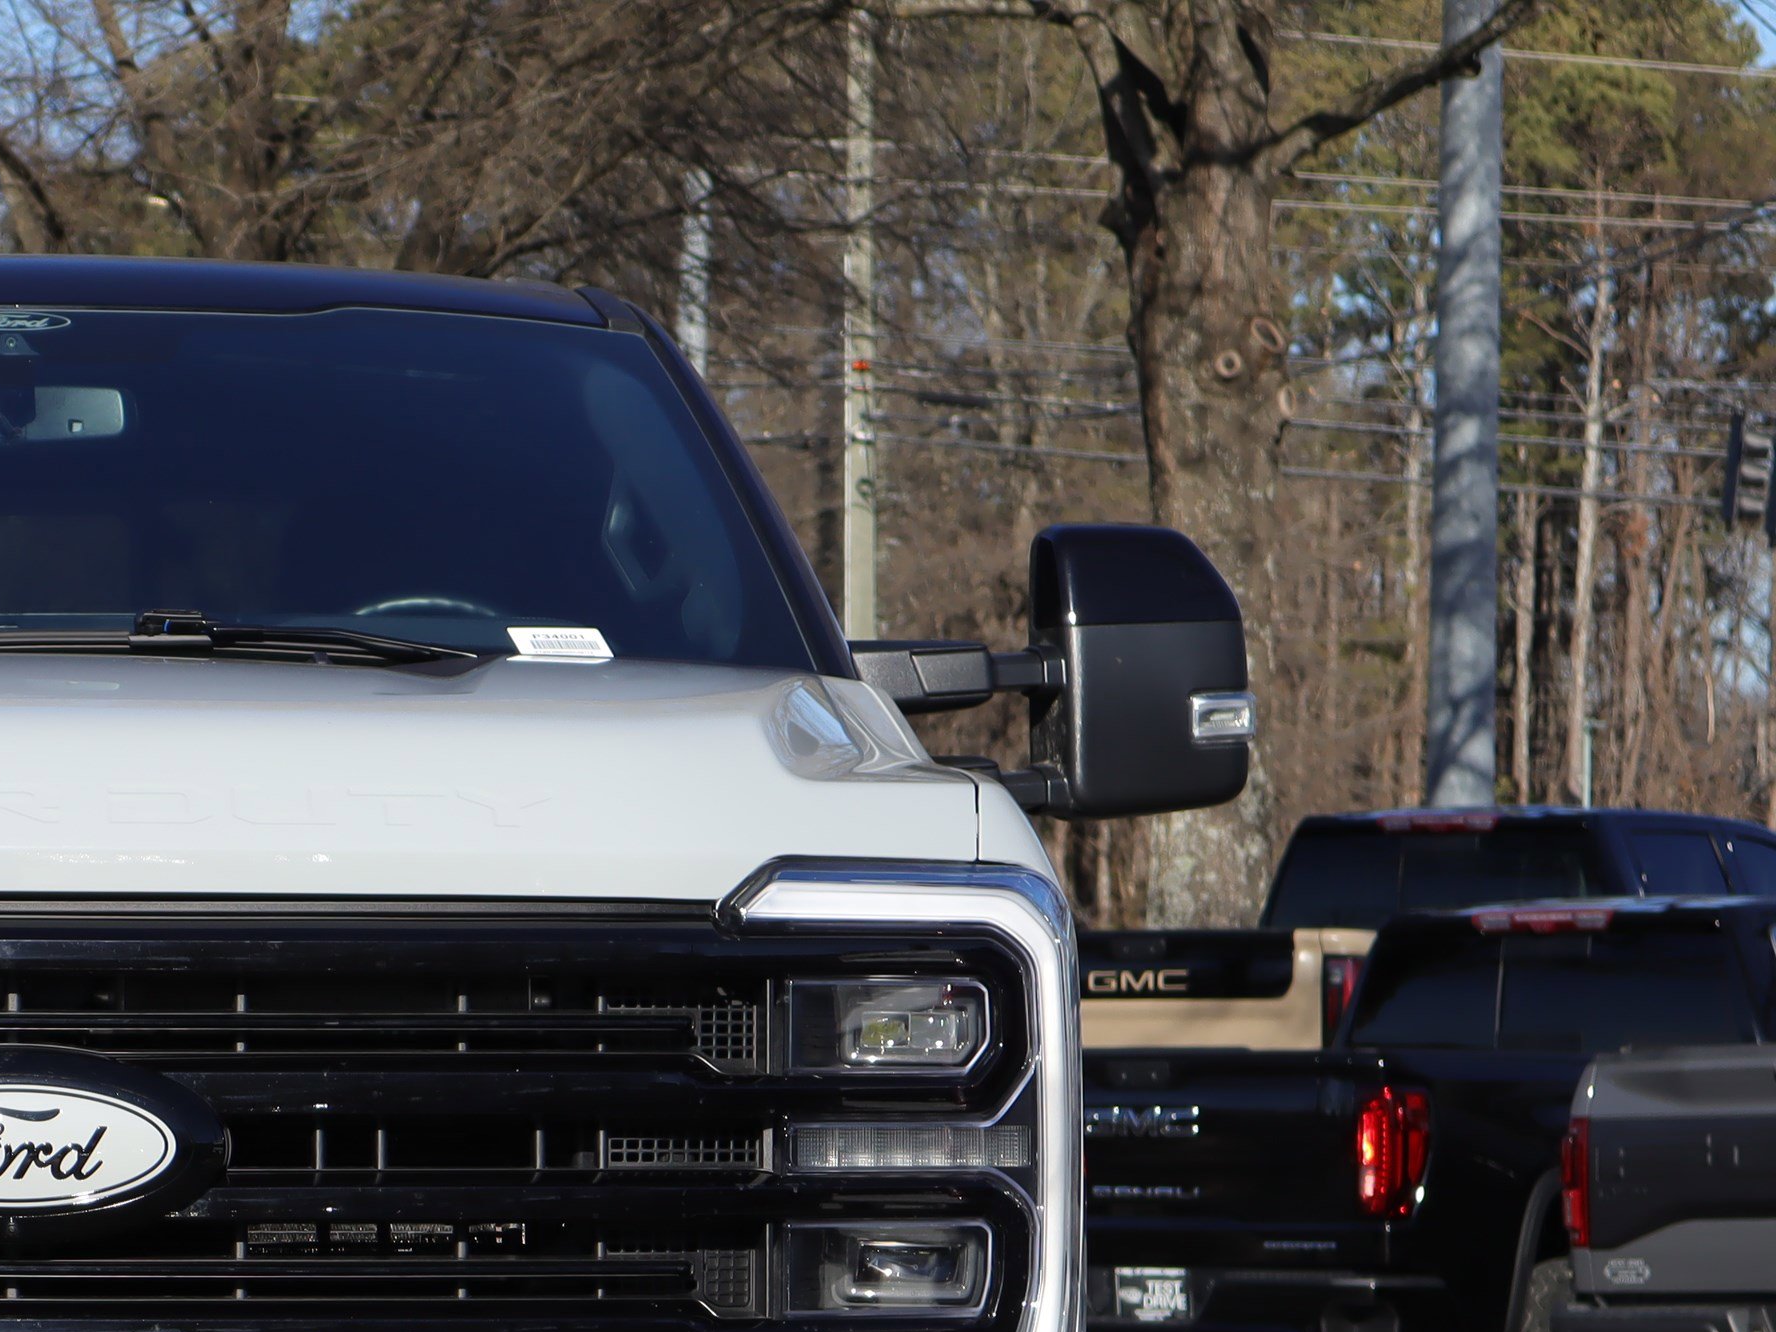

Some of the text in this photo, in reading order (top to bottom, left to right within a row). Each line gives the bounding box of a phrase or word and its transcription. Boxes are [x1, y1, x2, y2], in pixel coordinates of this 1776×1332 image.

[106, 787, 554, 828] DUTY
[1087, 969, 1188, 992] GMC
[1085, 1106, 1200, 1137] GMC
[1145, 1280, 1184, 1295] TEST
[1143, 1293, 1187, 1311] DRIVE
